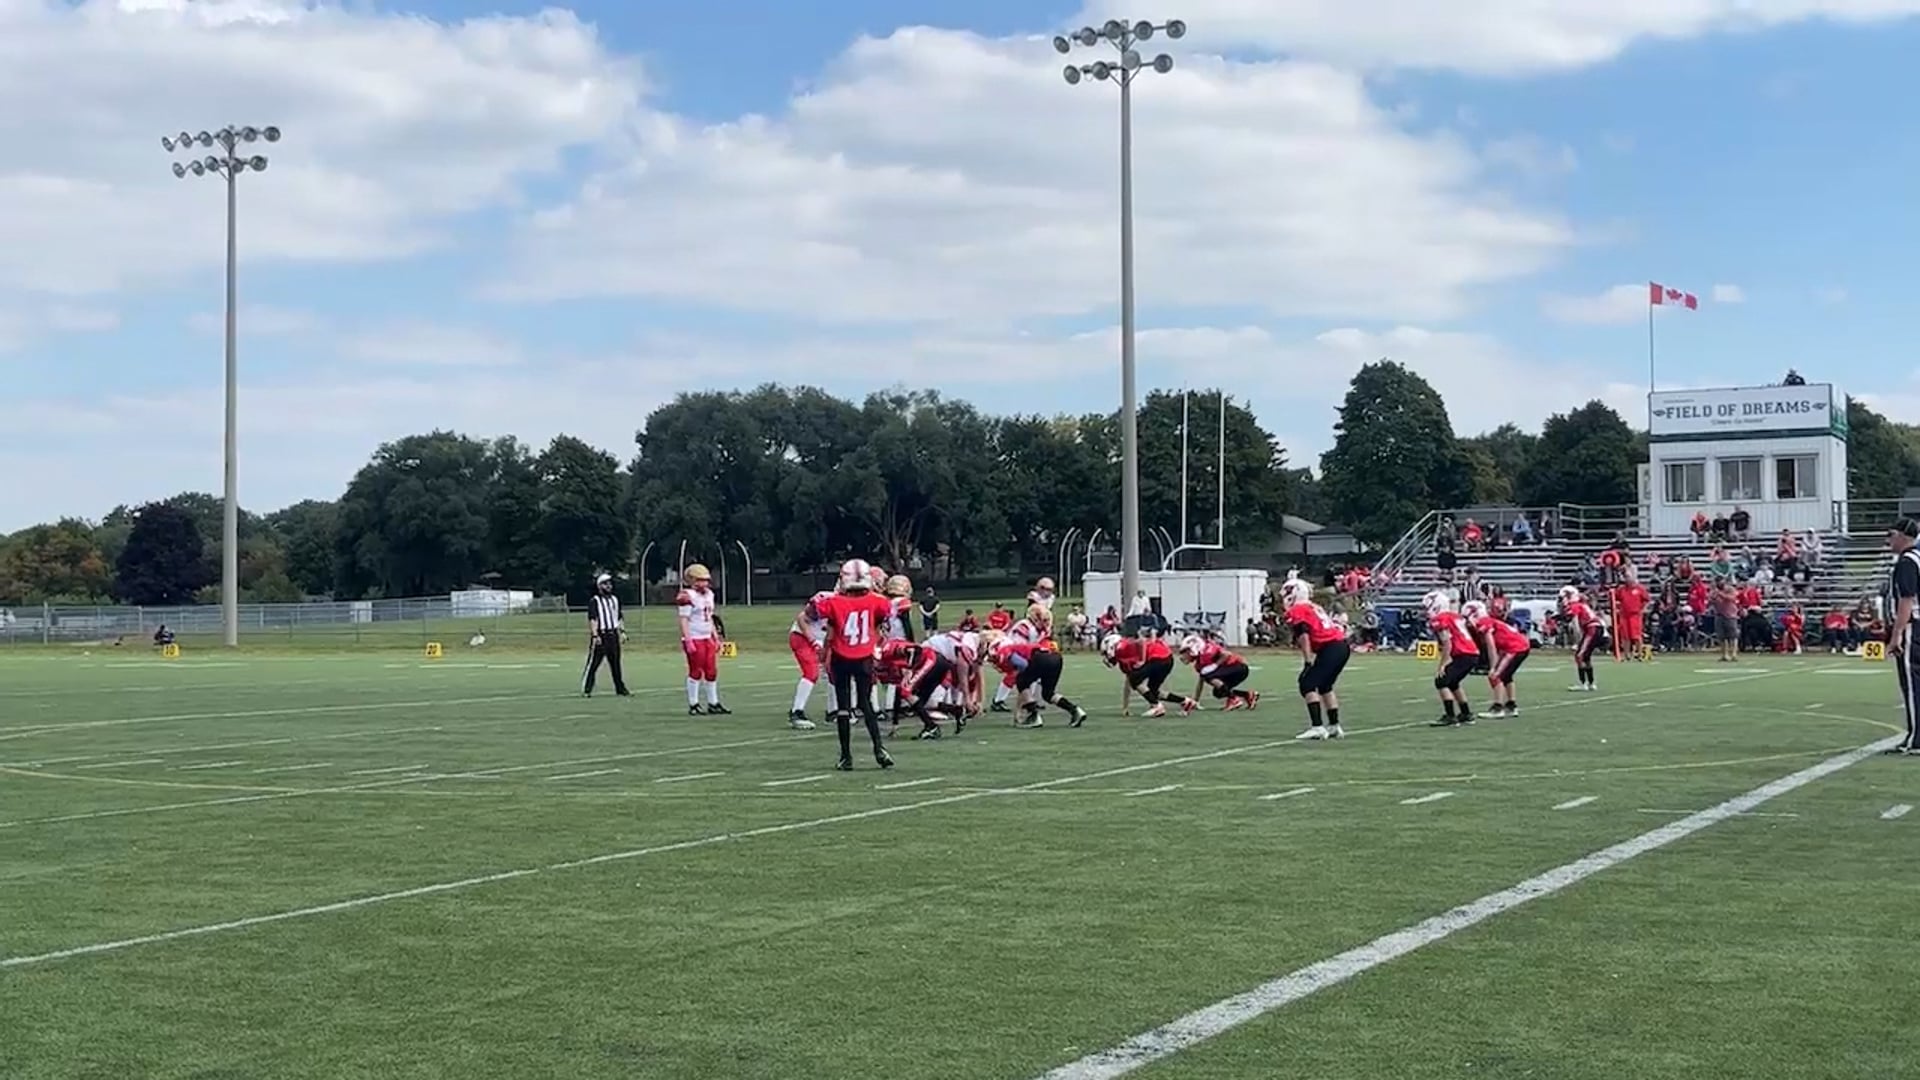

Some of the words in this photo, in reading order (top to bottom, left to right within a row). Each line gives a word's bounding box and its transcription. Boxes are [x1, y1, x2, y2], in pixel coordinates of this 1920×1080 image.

[1666, 404, 1712, 419] FIELD
[1718, 404, 1736, 417] OF
[1743, 400, 1811, 415] DREAMS
[843, 609, 870, 646] 41
[1419, 643, 1435, 657] 50
[1866, 643, 1881, 657] 50
